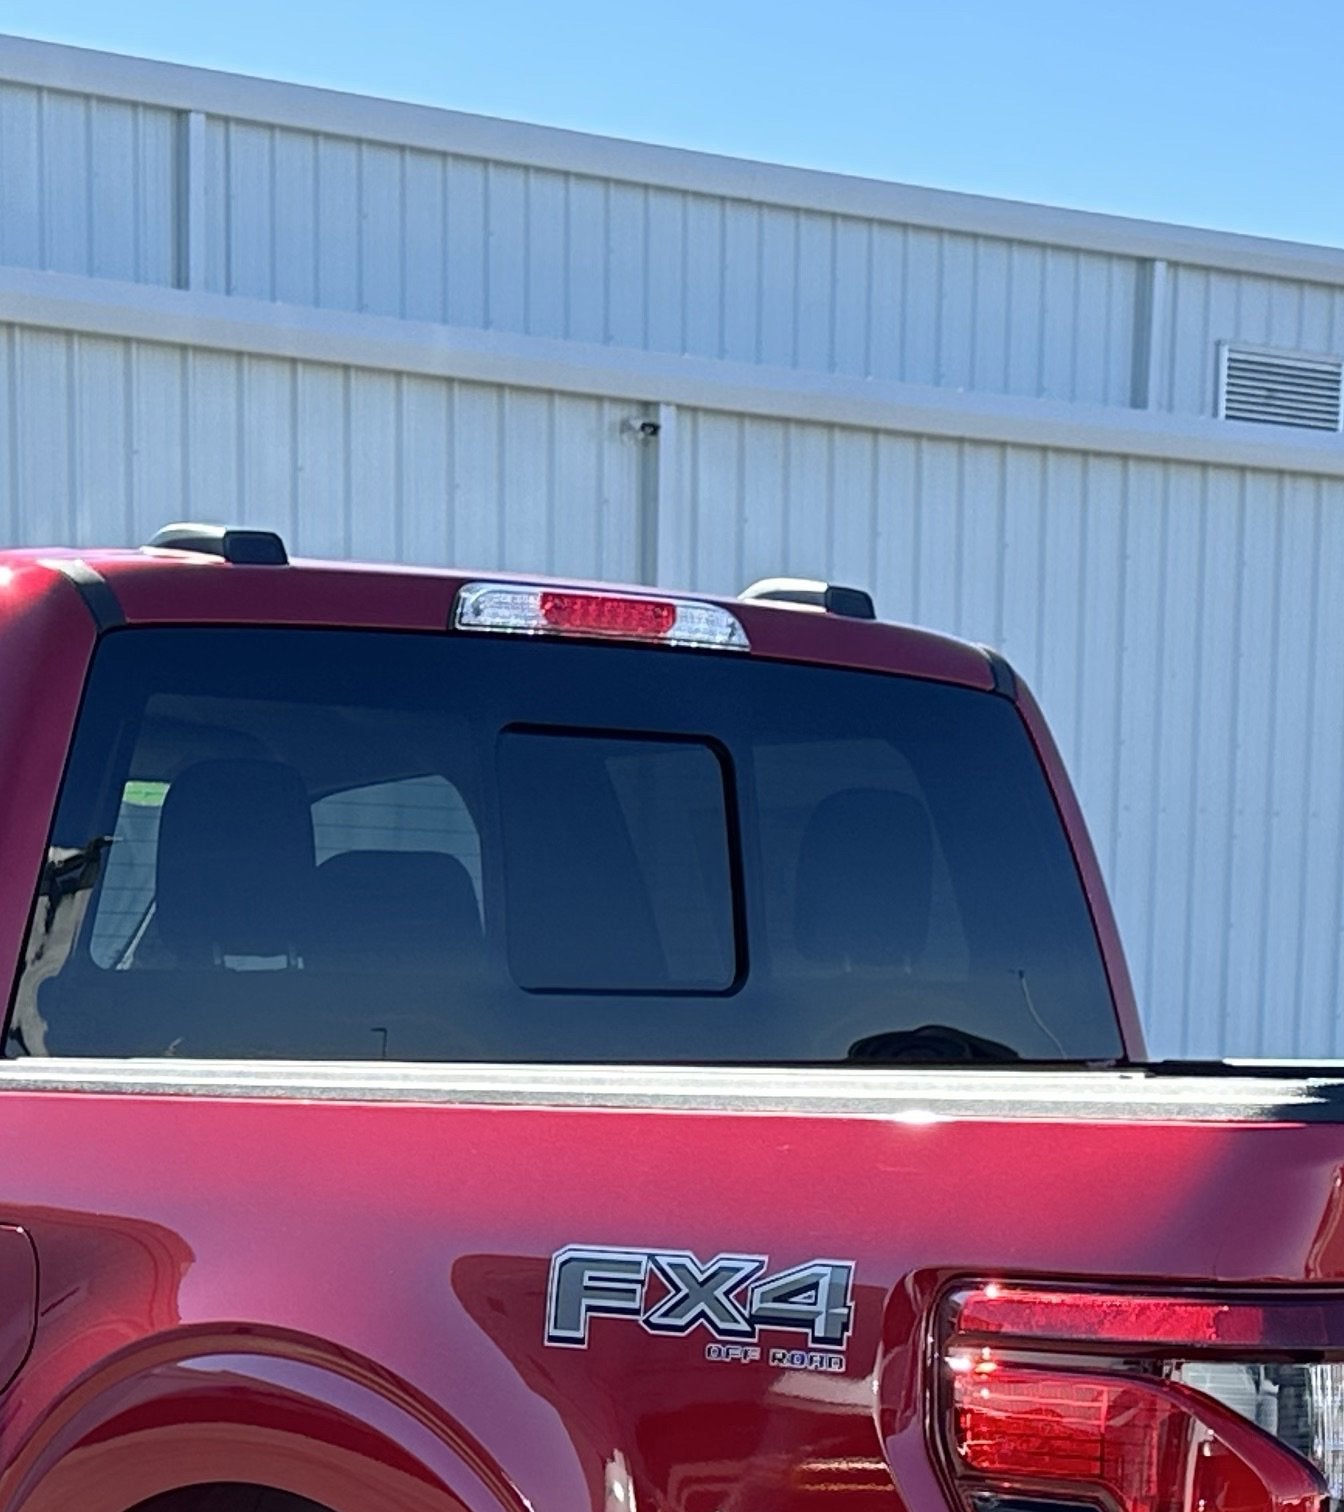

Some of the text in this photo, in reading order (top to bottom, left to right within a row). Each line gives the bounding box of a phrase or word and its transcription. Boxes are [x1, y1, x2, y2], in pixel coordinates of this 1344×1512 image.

[544, 1243, 856, 1350] FX4
[706, 1344, 846, 1372] OFF ROAD
